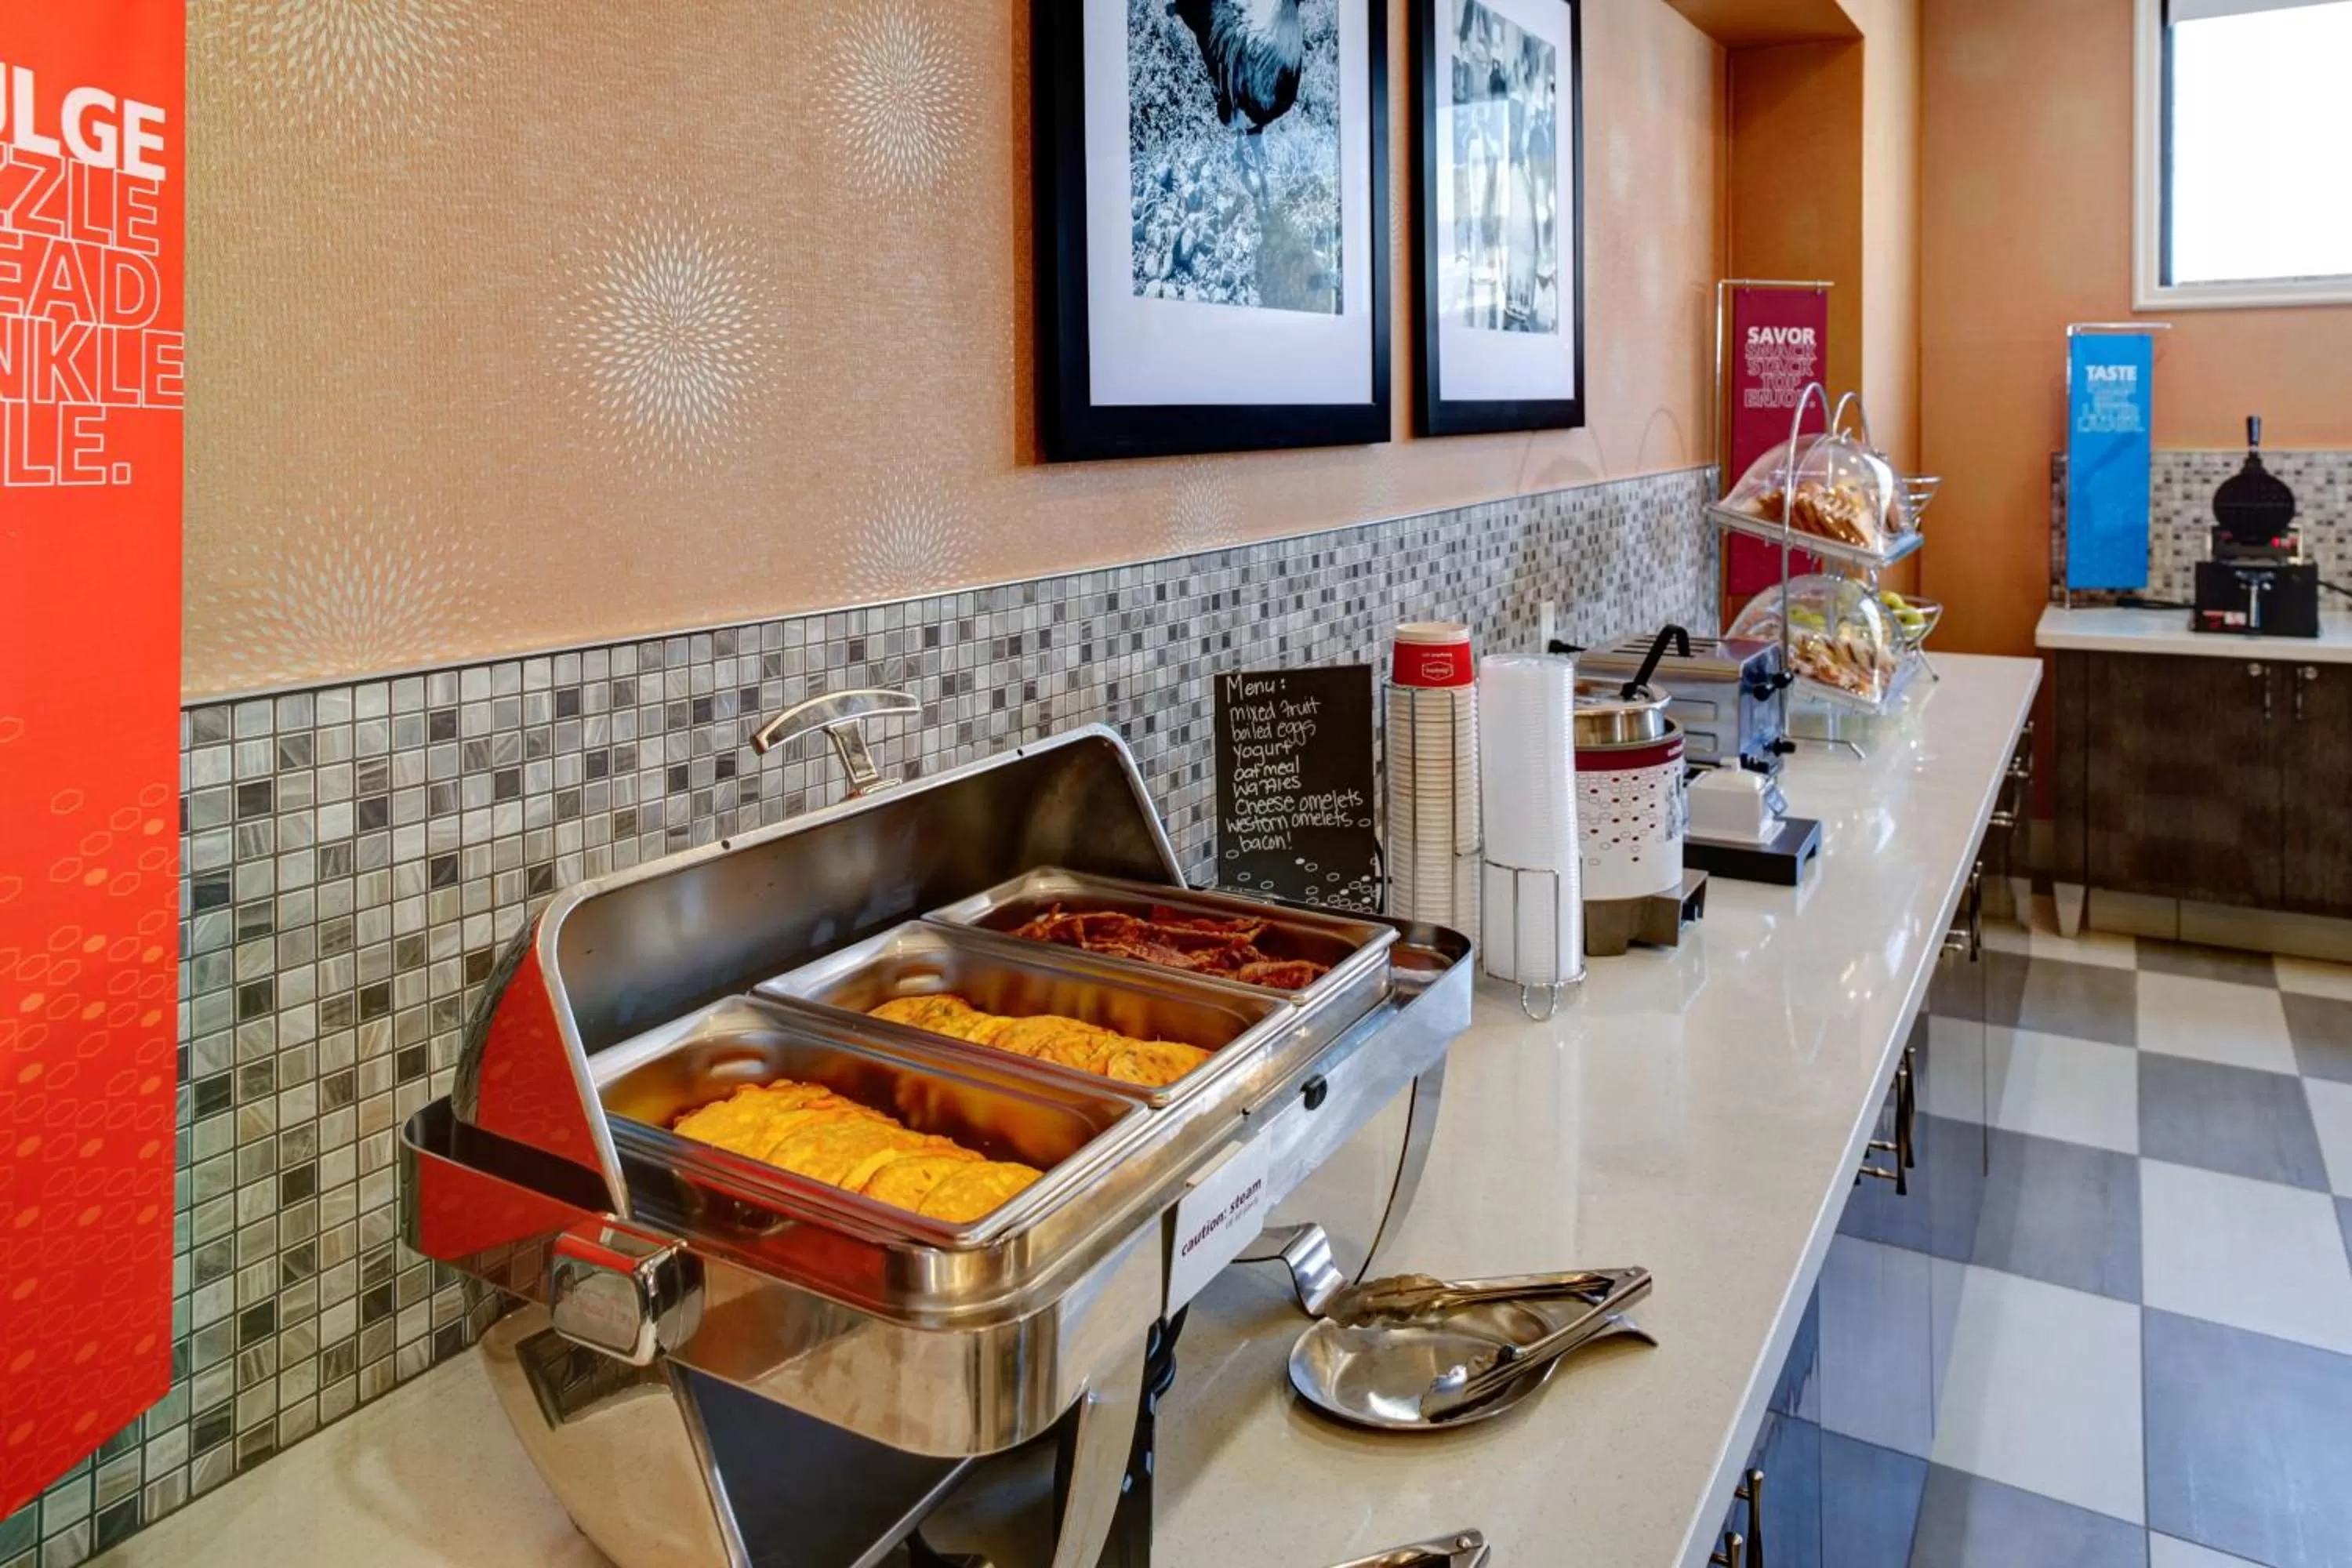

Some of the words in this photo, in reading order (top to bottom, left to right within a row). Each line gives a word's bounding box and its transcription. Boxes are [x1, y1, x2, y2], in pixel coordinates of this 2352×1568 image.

[0, 61, 166, 181] LGE
[0, 141, 159, 256] ZLE
[1747, 325, 1817, 345] SAVOR
[2085, 365, 2138, 382] TASTE
[1229, 700, 1276, 722] mixed
[1230, 720, 1272, 743] boiled
[1277, 719, 1317, 747] eggs
[1299, 787, 1364, 812] omelets
[1291, 808, 1354, 828] omelets
[1238, 830, 1293, 853] bacon!
[1181, 1207, 1228, 1258] caution:
[1229, 1178, 1262, 1214] steam
